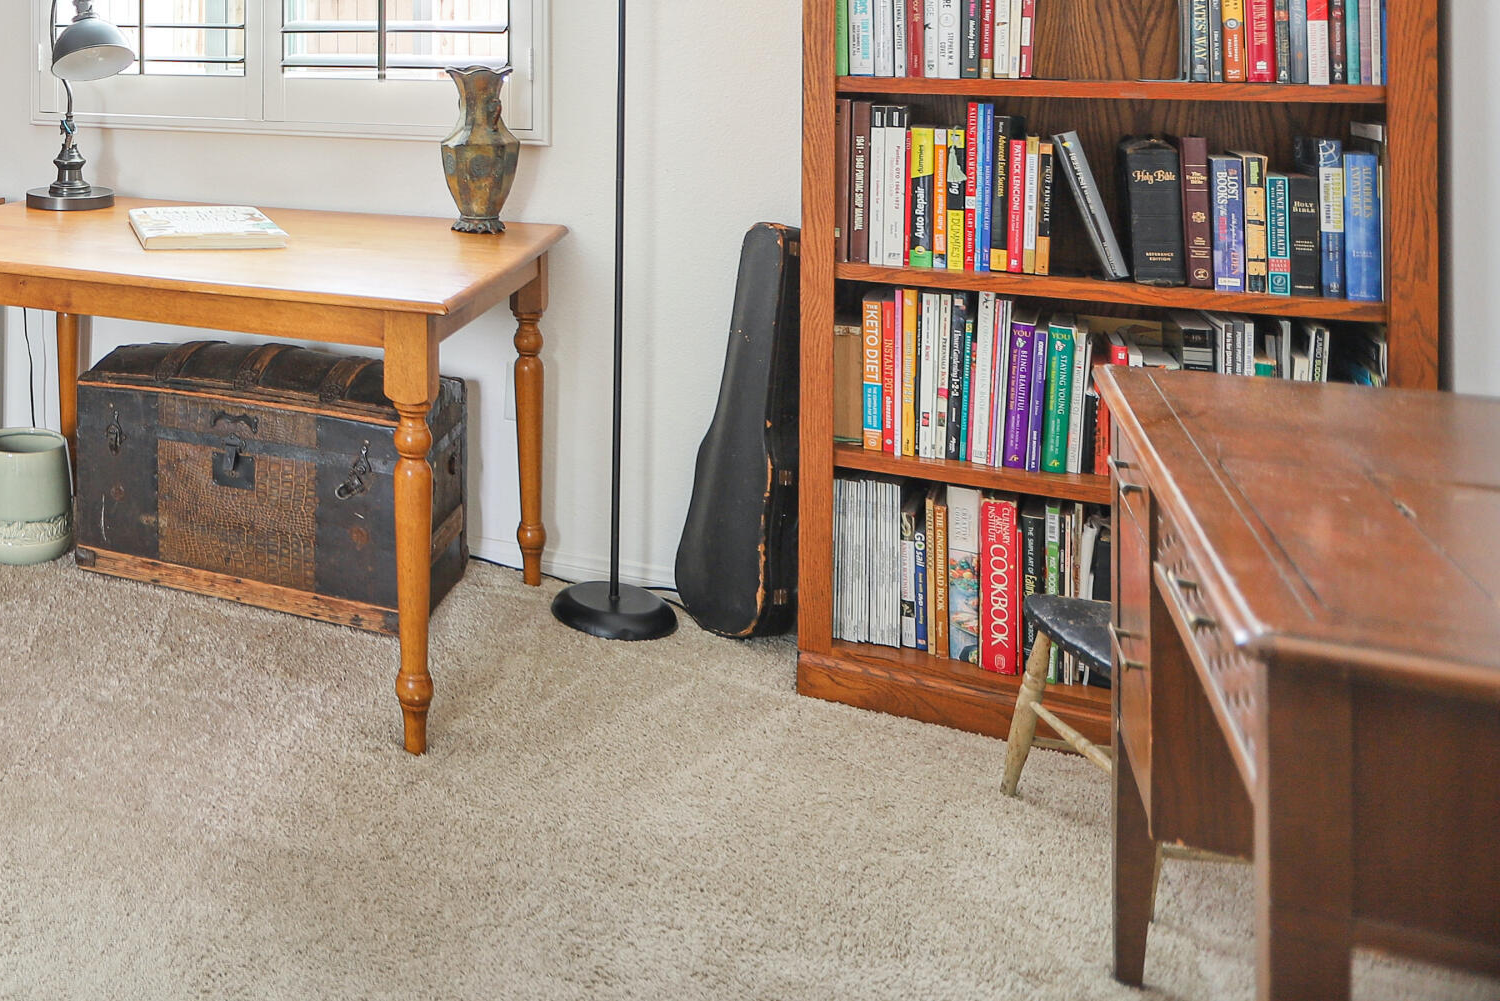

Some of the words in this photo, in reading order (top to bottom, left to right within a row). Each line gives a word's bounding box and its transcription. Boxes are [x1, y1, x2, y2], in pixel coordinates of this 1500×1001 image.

[968, 3, 976, 17] More
[967, 19, 976, 40] Melody
[1253, 20, 1267, 31] AND
[968, 40, 976, 59] Beattie
[1193, 36, 1207, 60] WAY
[969, 107, 977, 135] SAILING
[855, 135, 866, 149] 1941
[997, 134, 1007, 161] Advanced
[967, 137, 976, 193] FUNDAMENTALS
[998, 162, 1006, 173] Excel
[1012, 144, 1021, 174] PATRICK
[854, 169, 865, 192] PONTIAC
[997, 174, 1006, 197] Success
[1132, 169, 1154, 185] Holy
[1154, 169, 1176, 182] Bible
[1216, 171, 1228, 205] BOOKS
[1227, 175, 1239, 201] LOST
[854, 192, 865, 208] SHOP
[915, 186, 927, 216] Repair
[936, 194, 944, 214] Repair
[1012, 176, 1021, 211] LENCIONI
[1043, 184, 1051, 222] PRINCIPLE
[1276, 180, 1285, 210] SCIENCE
[1350, 166, 1361, 217] ANONYMOUS
[1362, 165, 1373, 218] ALCOHOLICS
[853, 207, 865, 231] MANUAL
[914, 216, 925, 239] Auto
[1276, 212, 1285, 227] AND
[950, 217, 961, 258] DUMMIES
[1277, 228, 1286, 257] HEALTH
[1230, 251, 1239, 275] EDEN
[866, 310, 878, 347] KETO
[1013, 328, 1032, 338] YOU
[1051, 332, 1071, 340] YOU
[884, 338, 893, 375] INSTANT
[1315, 335, 1323, 358] JUMBO
[866, 348, 878, 381] DIET
[951, 349, 960, 378] Gardening
[1019, 350, 1028, 373] BEING
[1059, 354, 1068, 386] STAYING
[884, 377, 893, 394] POT
[1017, 374, 1027, 411] BEAUTIFUL
[884, 395, 892, 429] obsession
[1057, 388, 1066, 415] YOUNG
[936, 511, 945, 528] THE
[987, 505, 997, 543] INSTITUTE
[994, 515, 1003, 534] ARTS
[1001, 506, 1012, 546] CULINARY
[915, 549, 925, 567] sail
[936, 529, 945, 586] GINGERBREAD
[1028, 564, 1034, 574] OF
[936, 588, 946, 610] BOOK
[989, 544, 1009, 648] COOKBOOK
